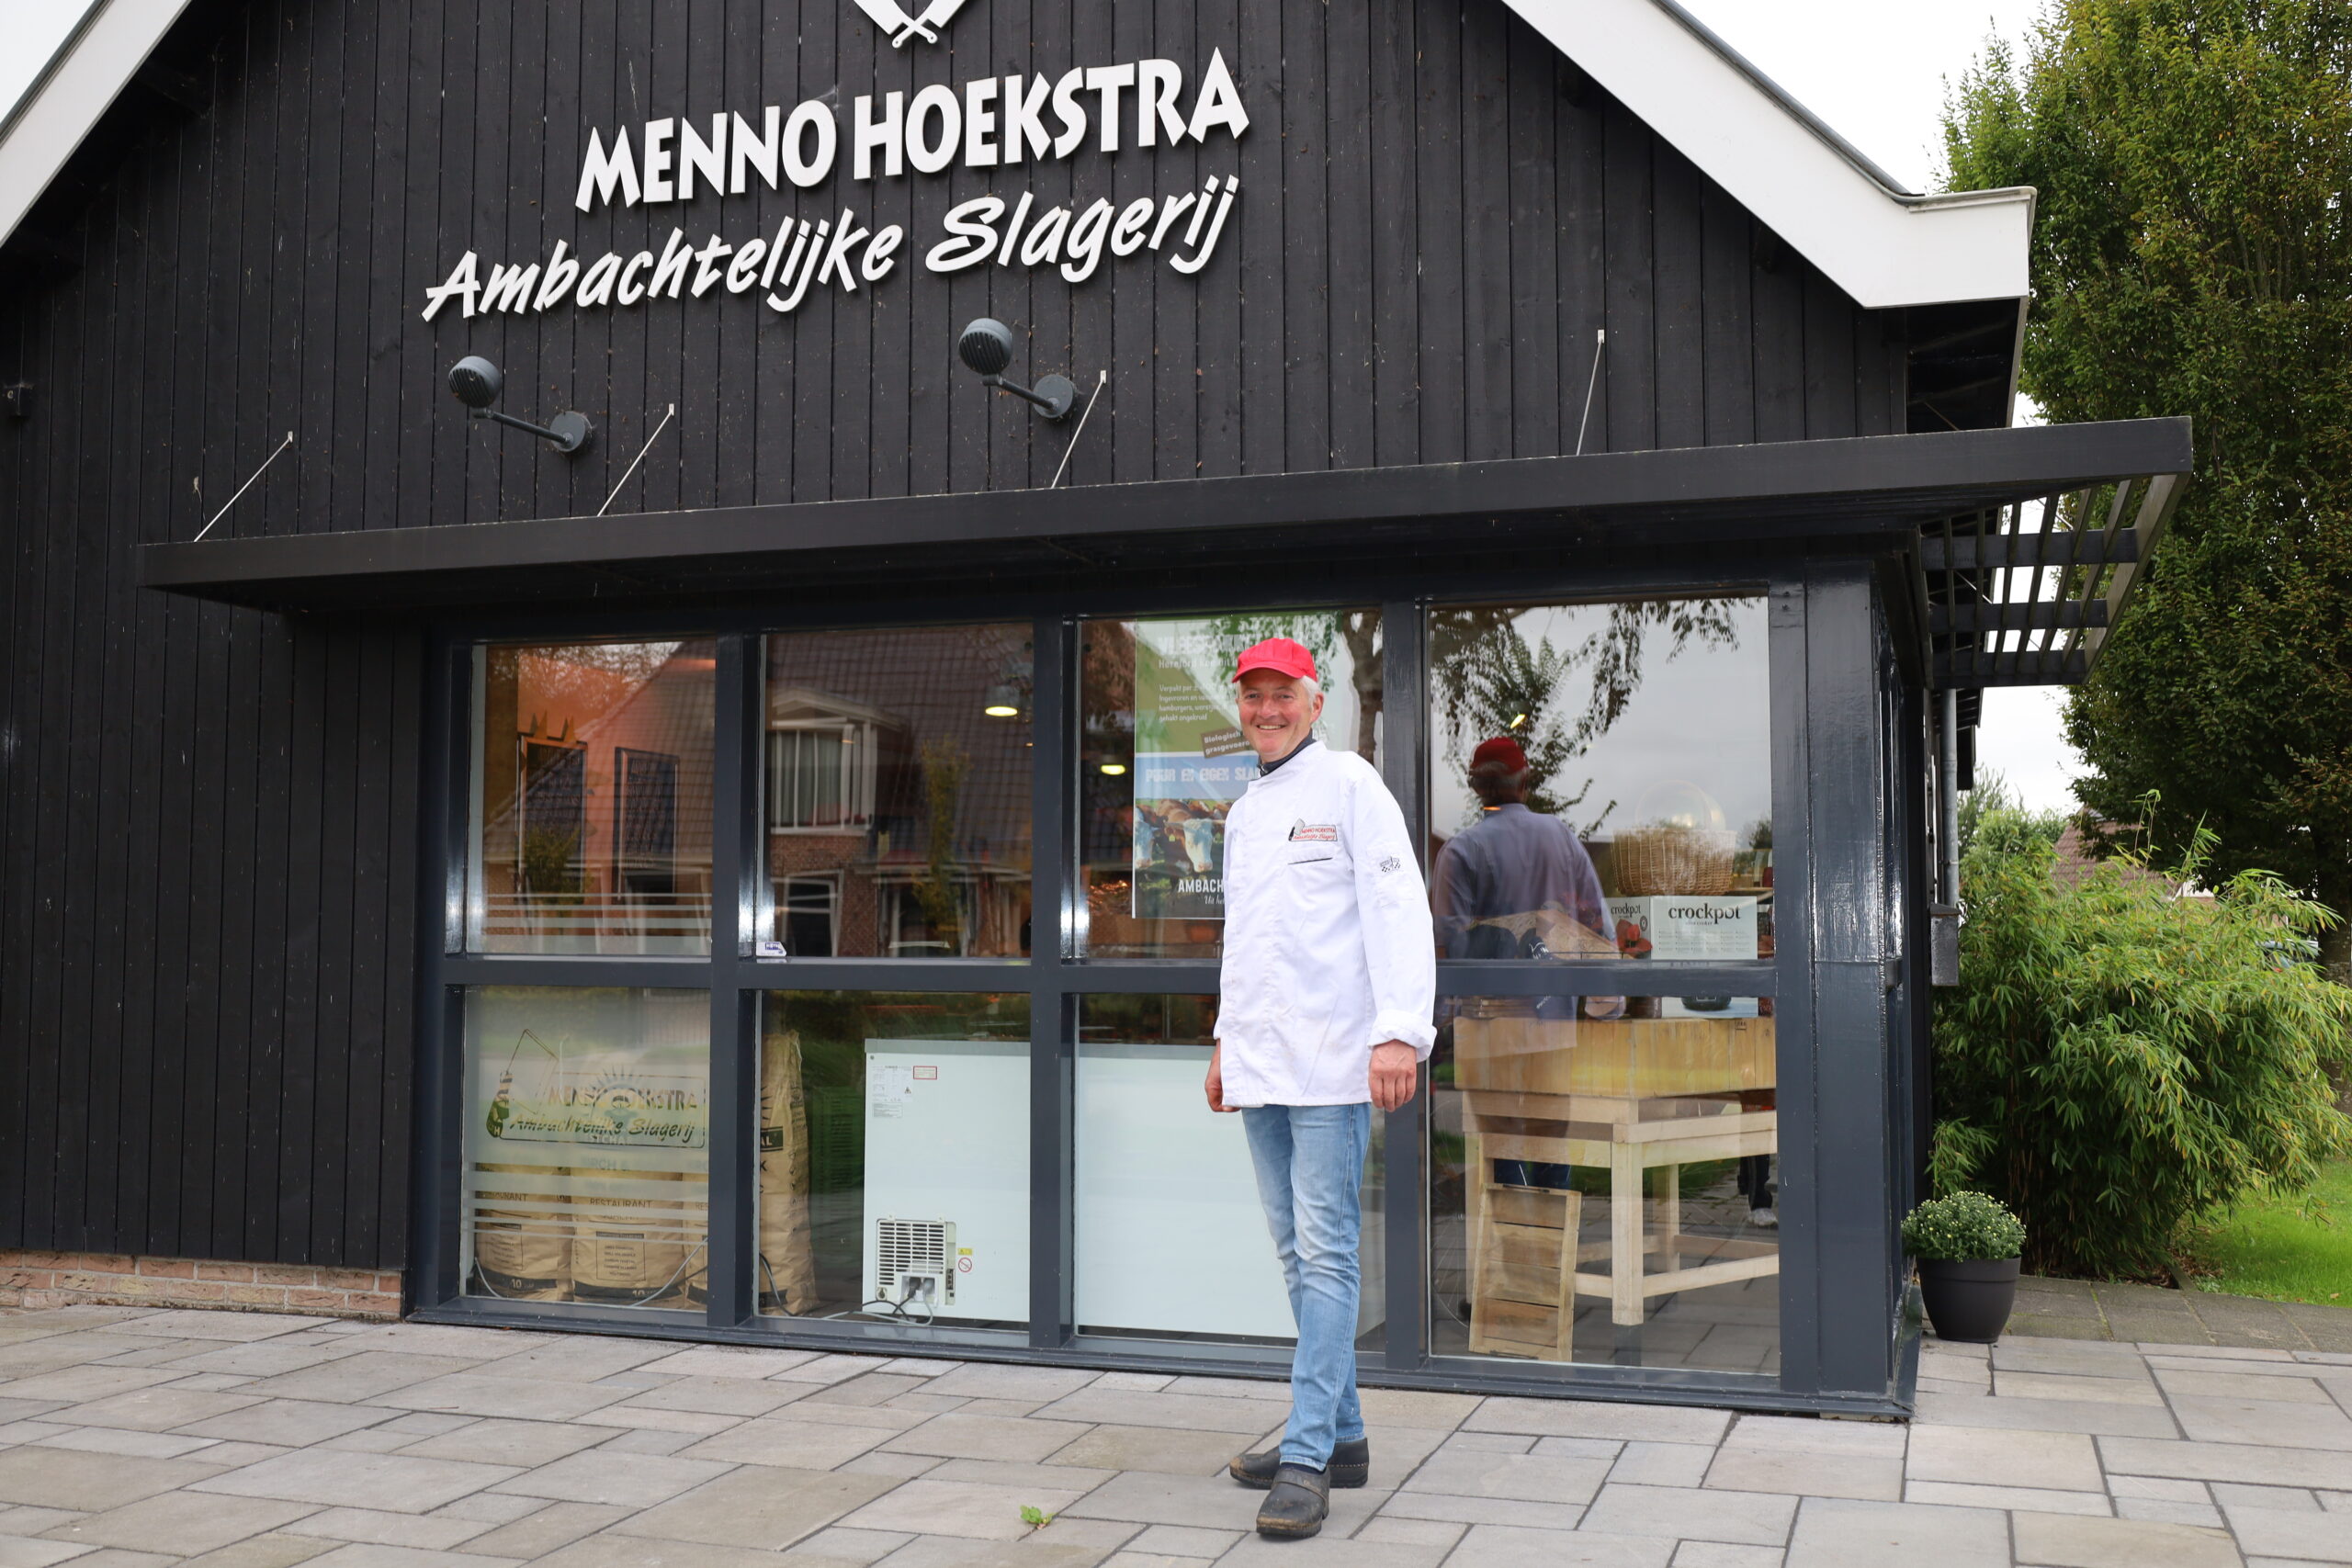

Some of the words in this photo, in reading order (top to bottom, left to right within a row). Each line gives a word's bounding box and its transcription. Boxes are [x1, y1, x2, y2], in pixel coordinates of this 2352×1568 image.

[575, 99, 837, 212] MENNO
[854, 46, 1250, 180] HOEKSTRA
[421, 207, 903, 322] Ambachtelijke
[925, 174, 1239, 283] Slagerij
[1611, 902, 1641, 919] crockpot
[1668, 903, 1741, 924] crockpot
[628, 1117, 695, 1144] Slagerij
[512, 1279, 522, 1289] 10
